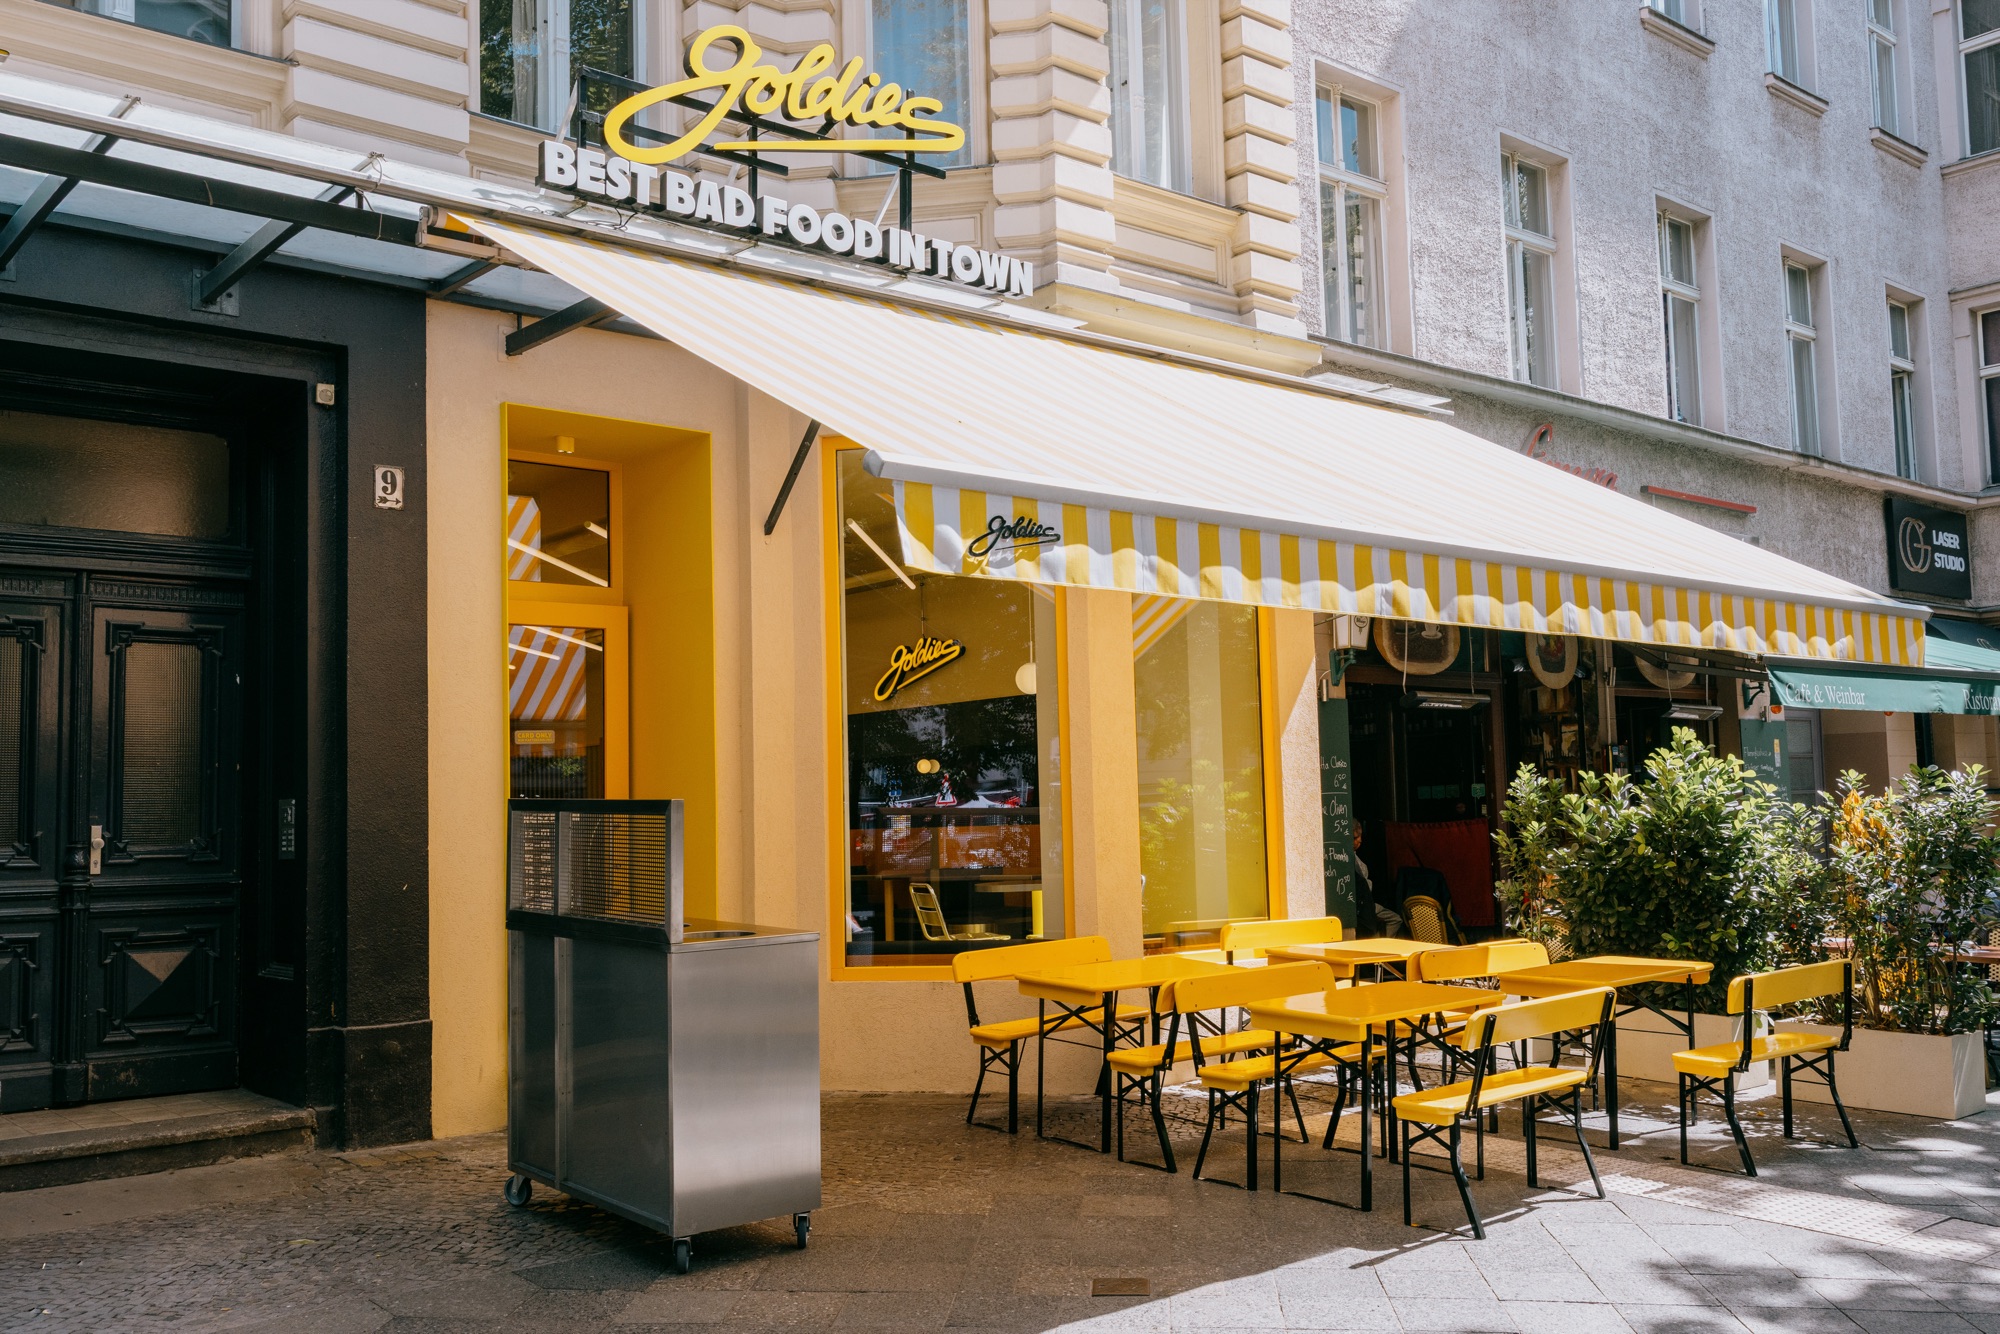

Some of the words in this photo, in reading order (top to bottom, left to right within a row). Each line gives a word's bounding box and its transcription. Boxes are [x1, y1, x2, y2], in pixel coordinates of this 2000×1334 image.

[543, 140, 658, 206] BEST
[665, 170, 755, 228] BAD
[761, 195, 883, 259] FOOD
[888, 226, 926, 273] IN
[931, 238, 1034, 297] TOWN
[381, 469, 398, 496] 9
[1932, 529, 1960, 550] LASER
[1934, 552, 1966, 572] STUDIO
[1785, 681, 1811, 704] Café
[1813, 684, 1824, 704] &
[1825, 685, 1866, 706] Weinbar
